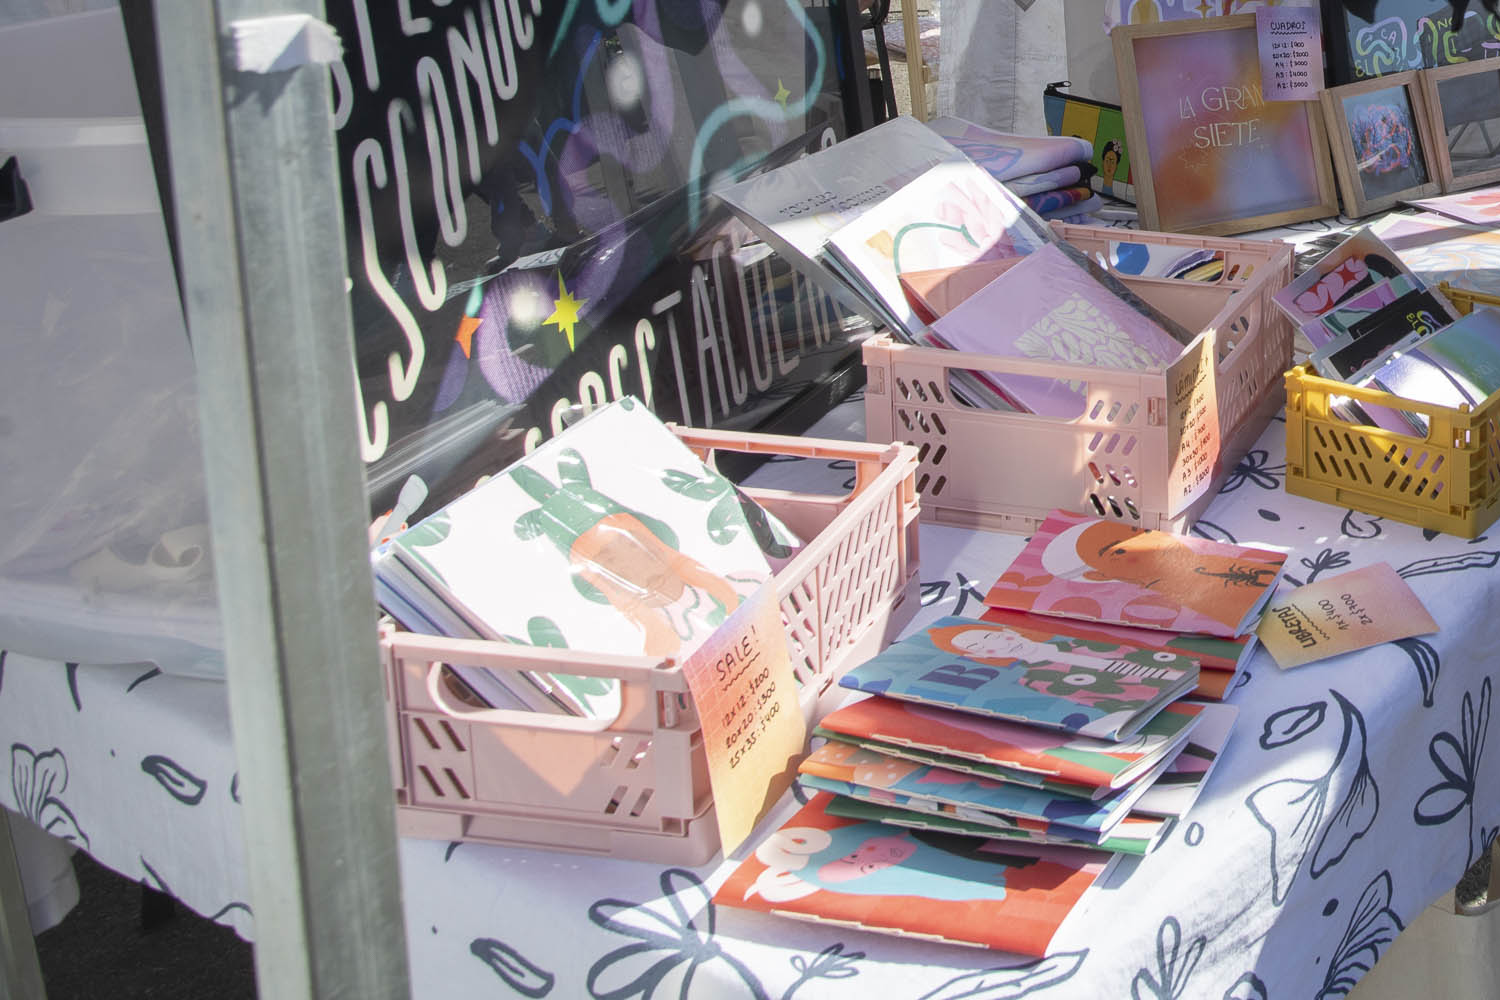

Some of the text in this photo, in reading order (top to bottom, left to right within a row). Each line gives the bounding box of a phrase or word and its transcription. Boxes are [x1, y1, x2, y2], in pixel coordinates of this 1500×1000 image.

[1270, 20, 1306, 31] CUADROS
[1179, 95, 1196, 119] LA
[1201, 83, 1265, 111] GRAN
[1194, 119, 1261, 149] SIETE
[1271, 605, 1317, 649] LIBRETAS
